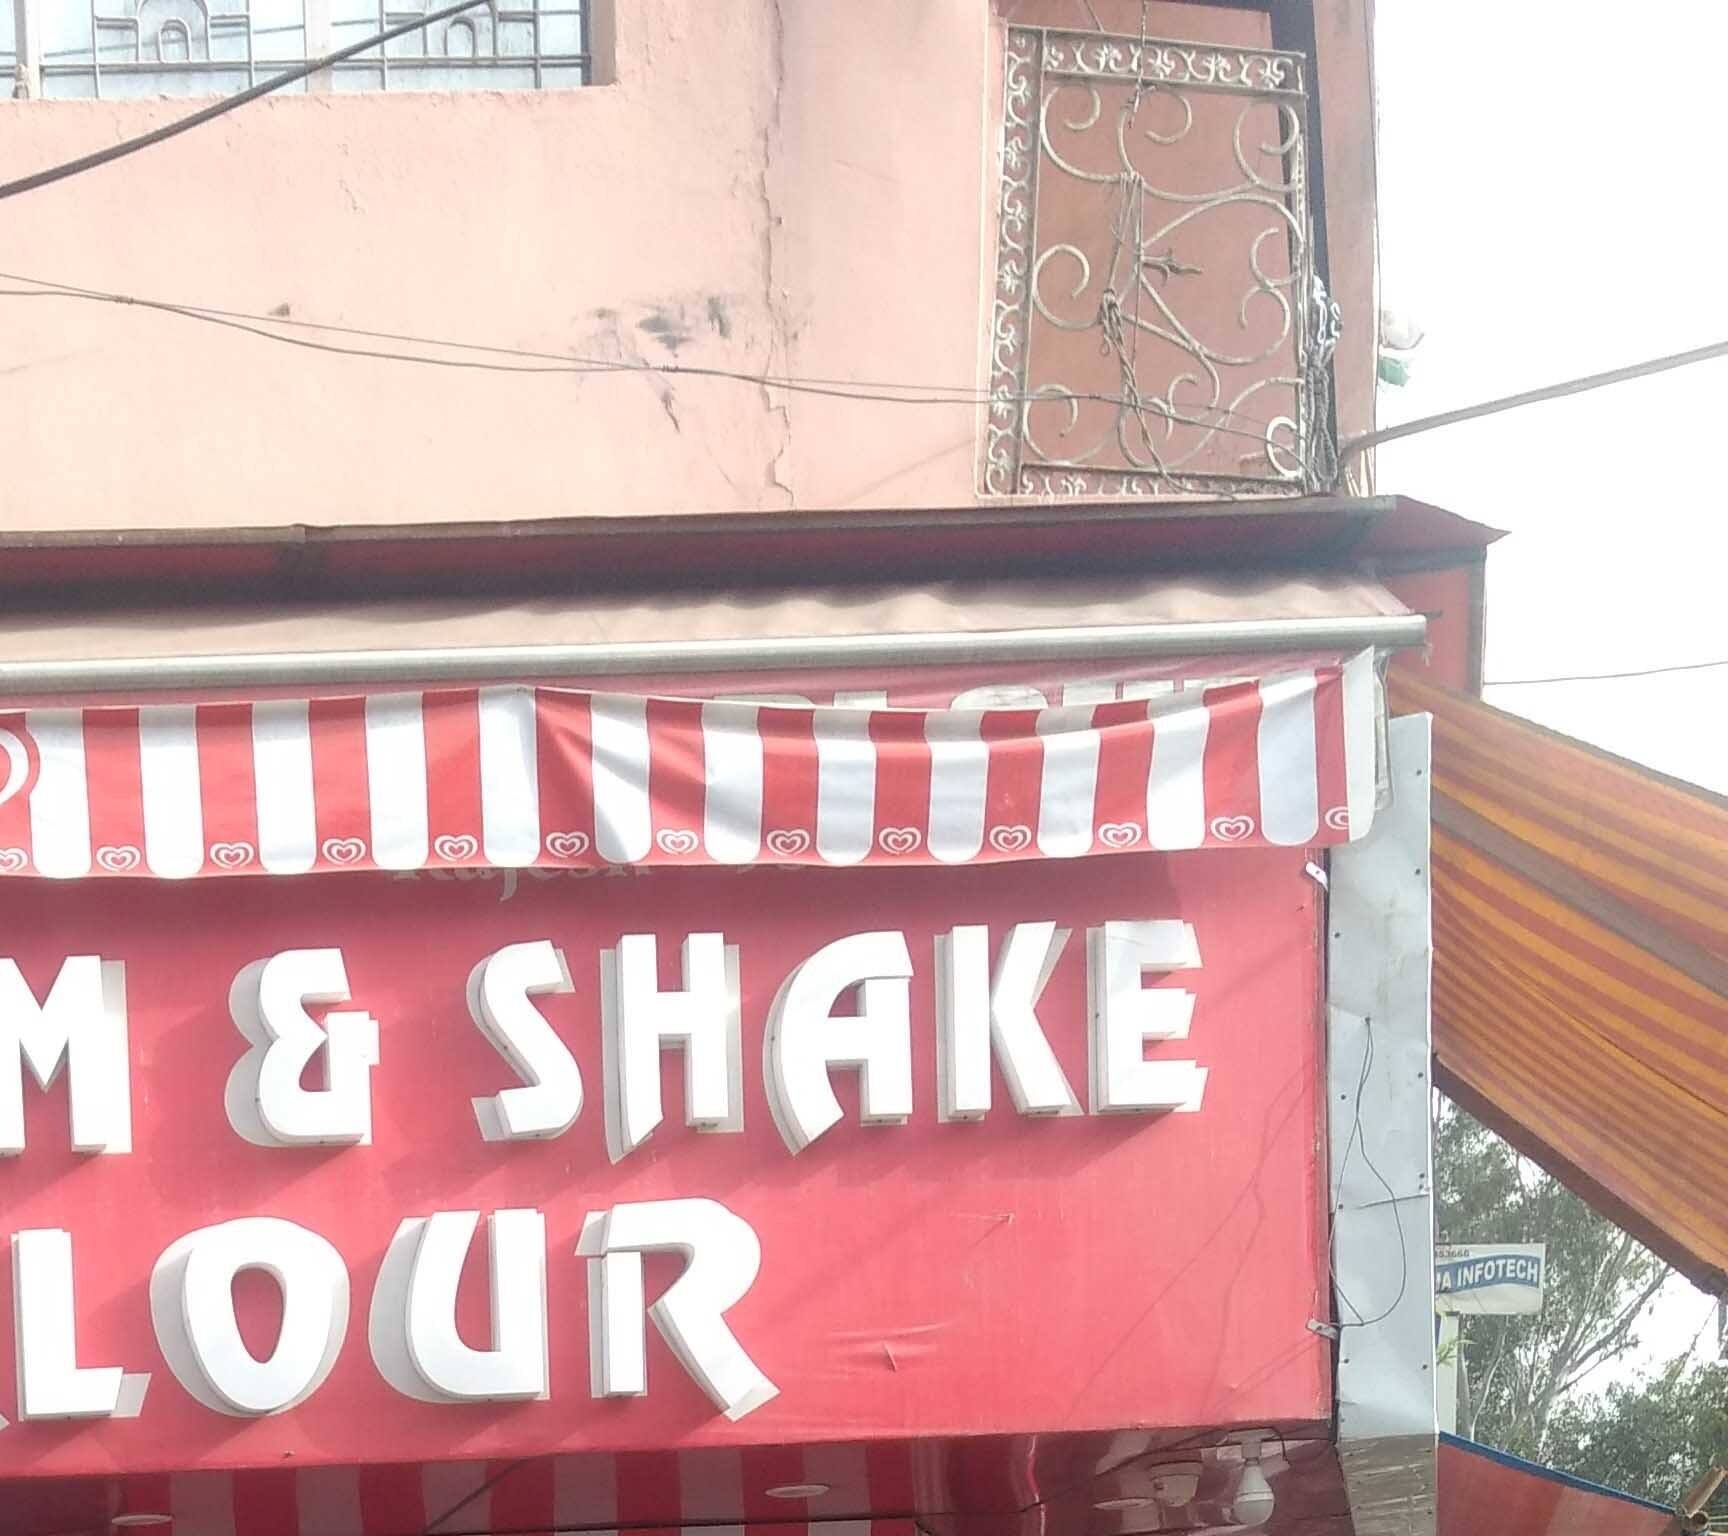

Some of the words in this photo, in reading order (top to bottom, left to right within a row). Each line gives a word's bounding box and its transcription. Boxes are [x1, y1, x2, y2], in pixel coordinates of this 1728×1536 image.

[224, 947, 379, 1149] &
[467, 919, 1208, 1163] SHAKE
[1457, 1258, 1539, 1288] INFOTECH
